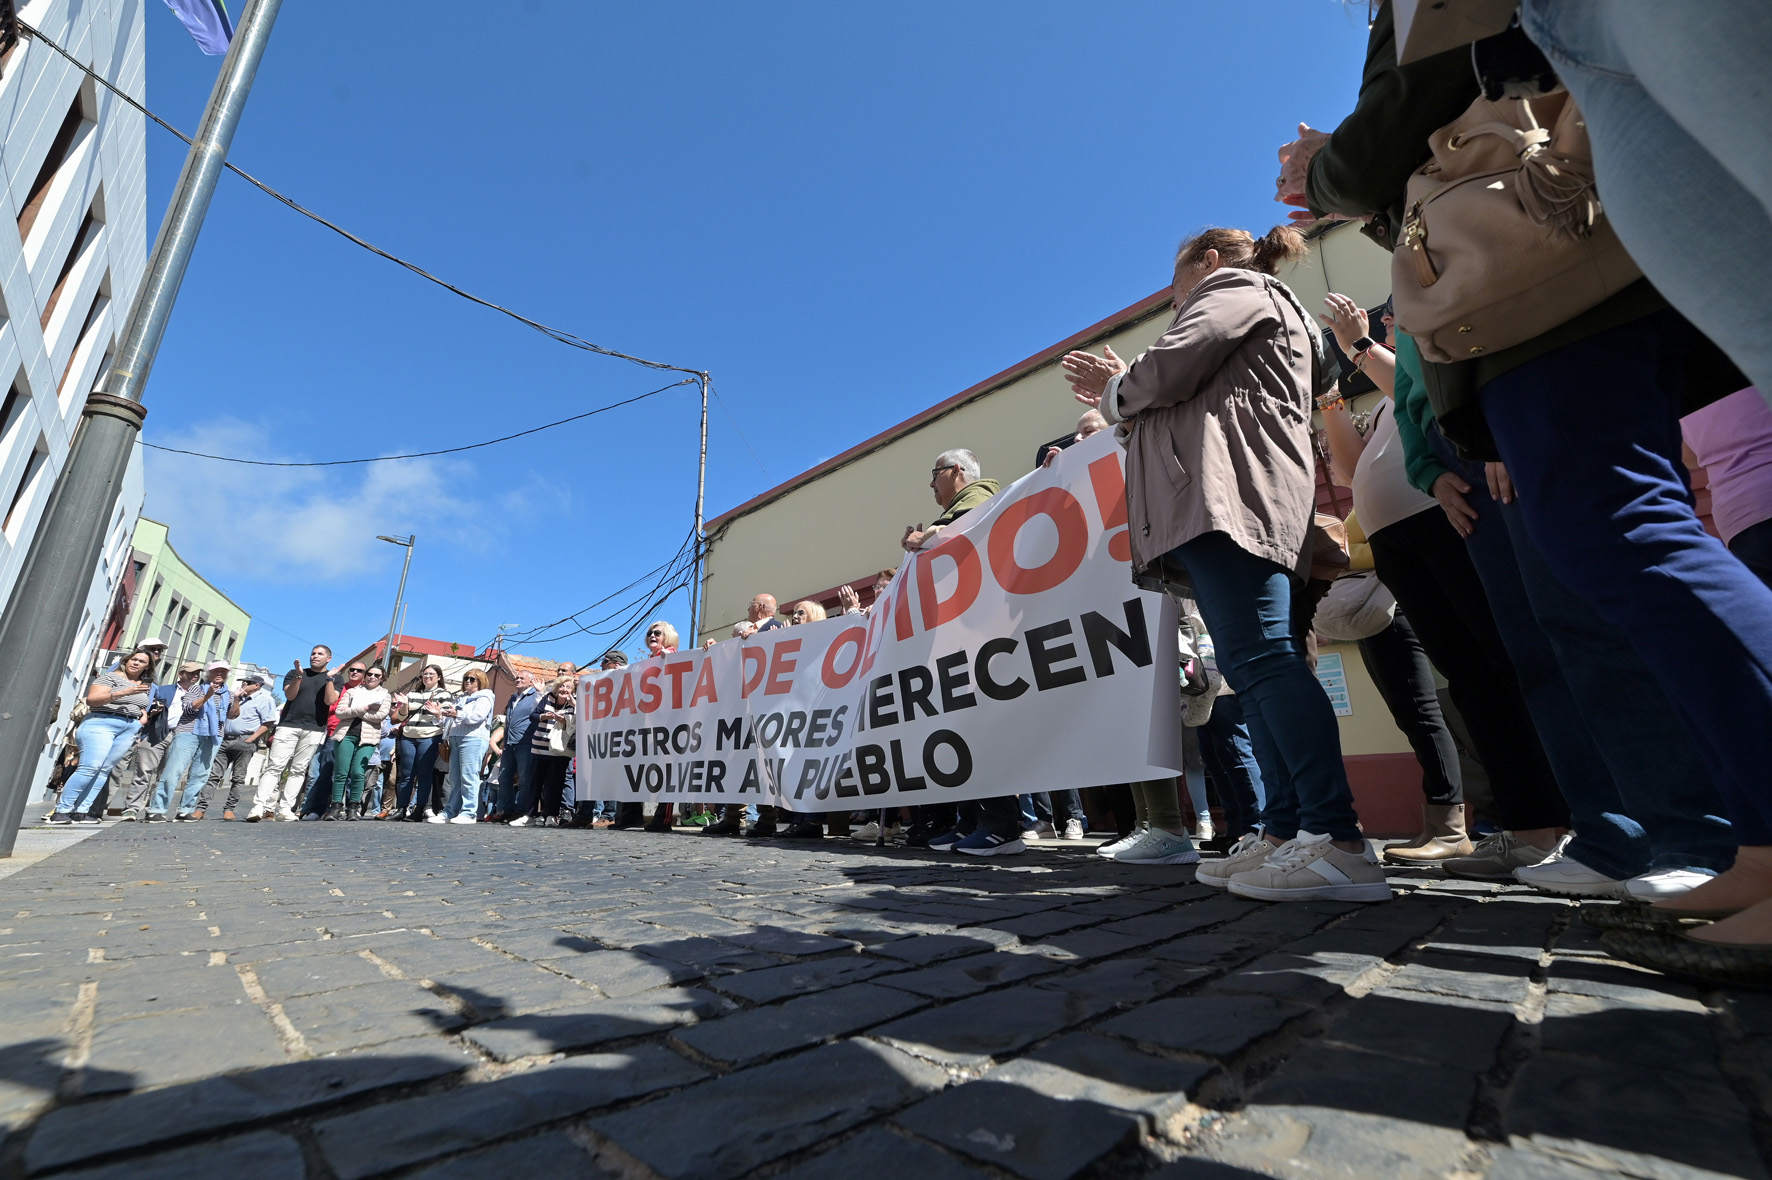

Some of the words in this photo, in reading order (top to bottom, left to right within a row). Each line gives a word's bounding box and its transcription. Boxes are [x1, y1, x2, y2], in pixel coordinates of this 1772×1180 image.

[584, 656, 719, 722] ¡BASTA
[741, 638, 803, 700] DE
[587, 721, 703, 760] NUESTROS
[623, 759, 727, 793] VOLVER
[738, 758, 761, 794] A
[793, 728, 974, 800] PUEBLO
